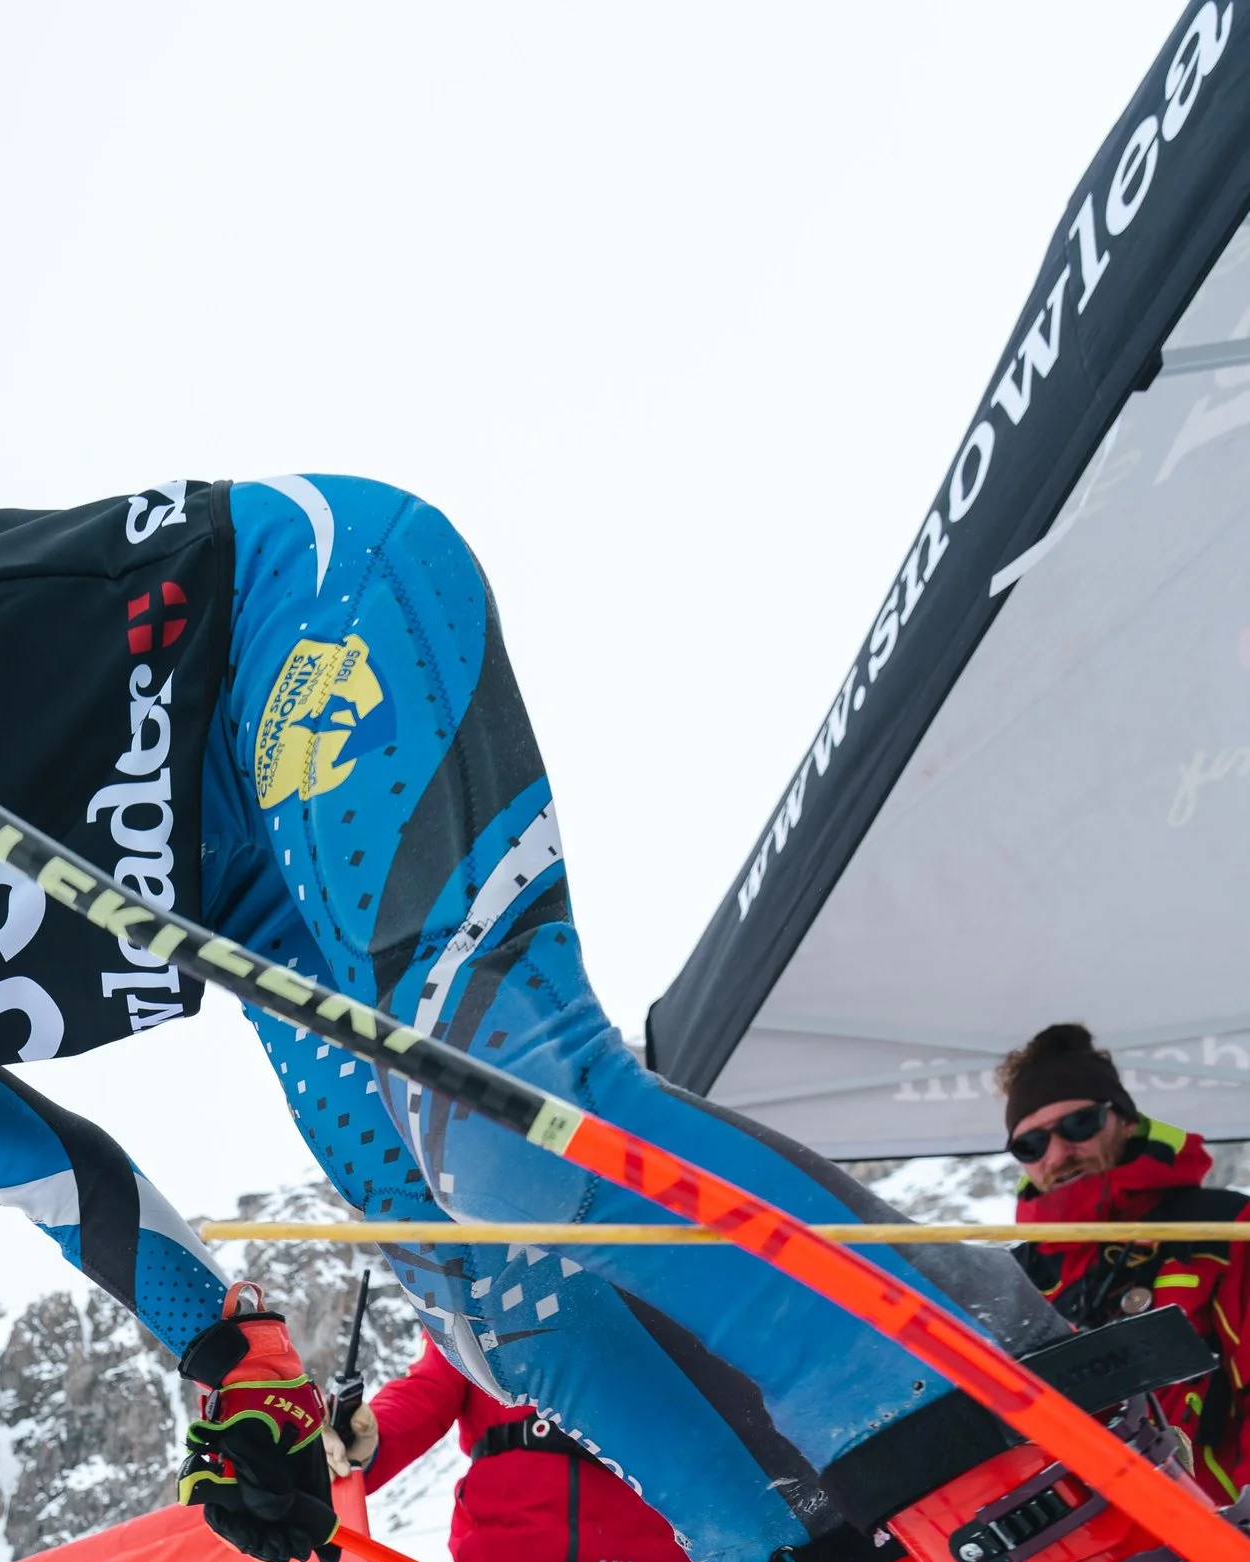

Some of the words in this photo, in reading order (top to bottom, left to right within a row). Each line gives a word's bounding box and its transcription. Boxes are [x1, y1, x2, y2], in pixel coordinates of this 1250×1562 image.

[334, 650, 361, 684] 1905
[260, 719, 274, 749] DES
[270, 654, 305, 714] SPORTS
[261, 652, 324, 798] CHAMONIX
[263, 1394, 314, 1428] LEKI
